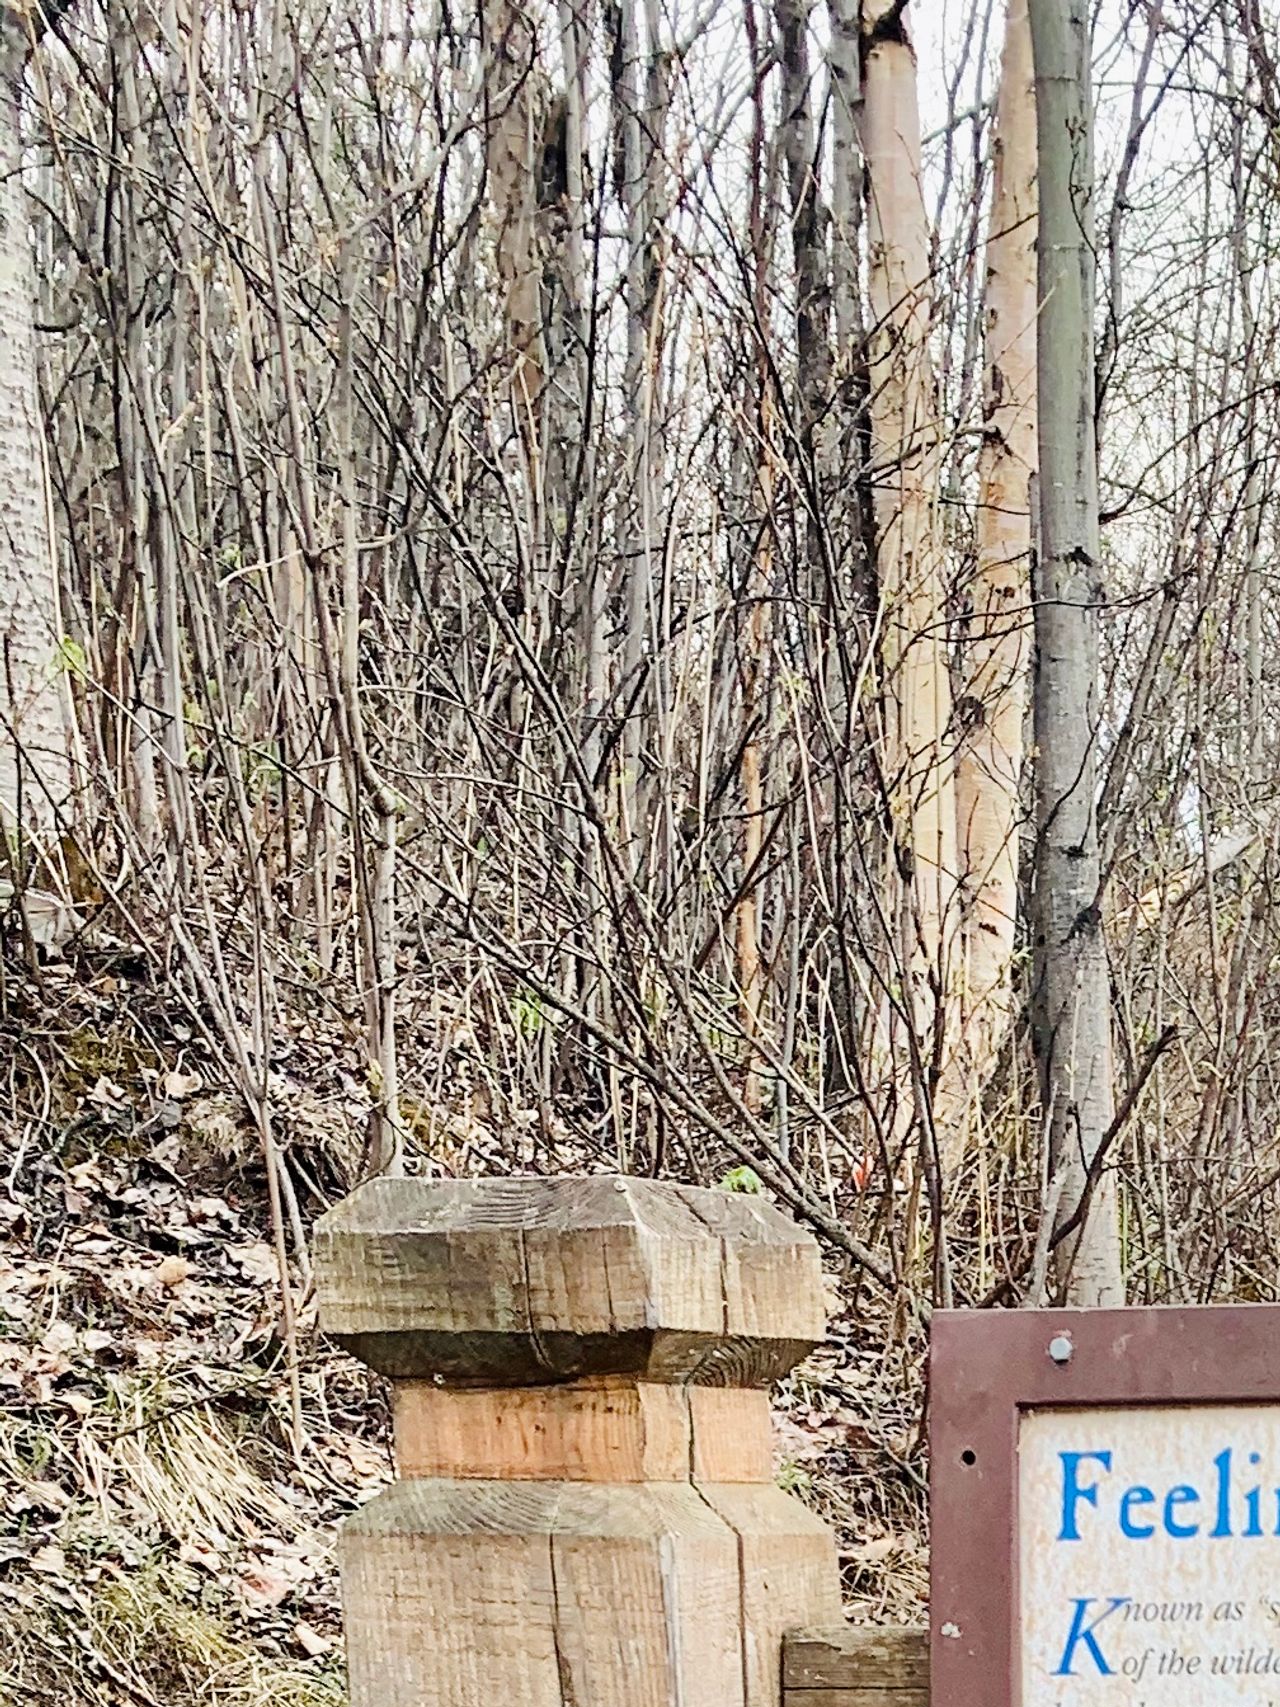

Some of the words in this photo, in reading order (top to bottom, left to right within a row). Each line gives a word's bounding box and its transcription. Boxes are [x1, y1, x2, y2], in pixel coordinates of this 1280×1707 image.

[1213, 1600, 1245, 1621] as
[1122, 1648, 1154, 1683] of
[1158, 1650, 1201, 1675] the
